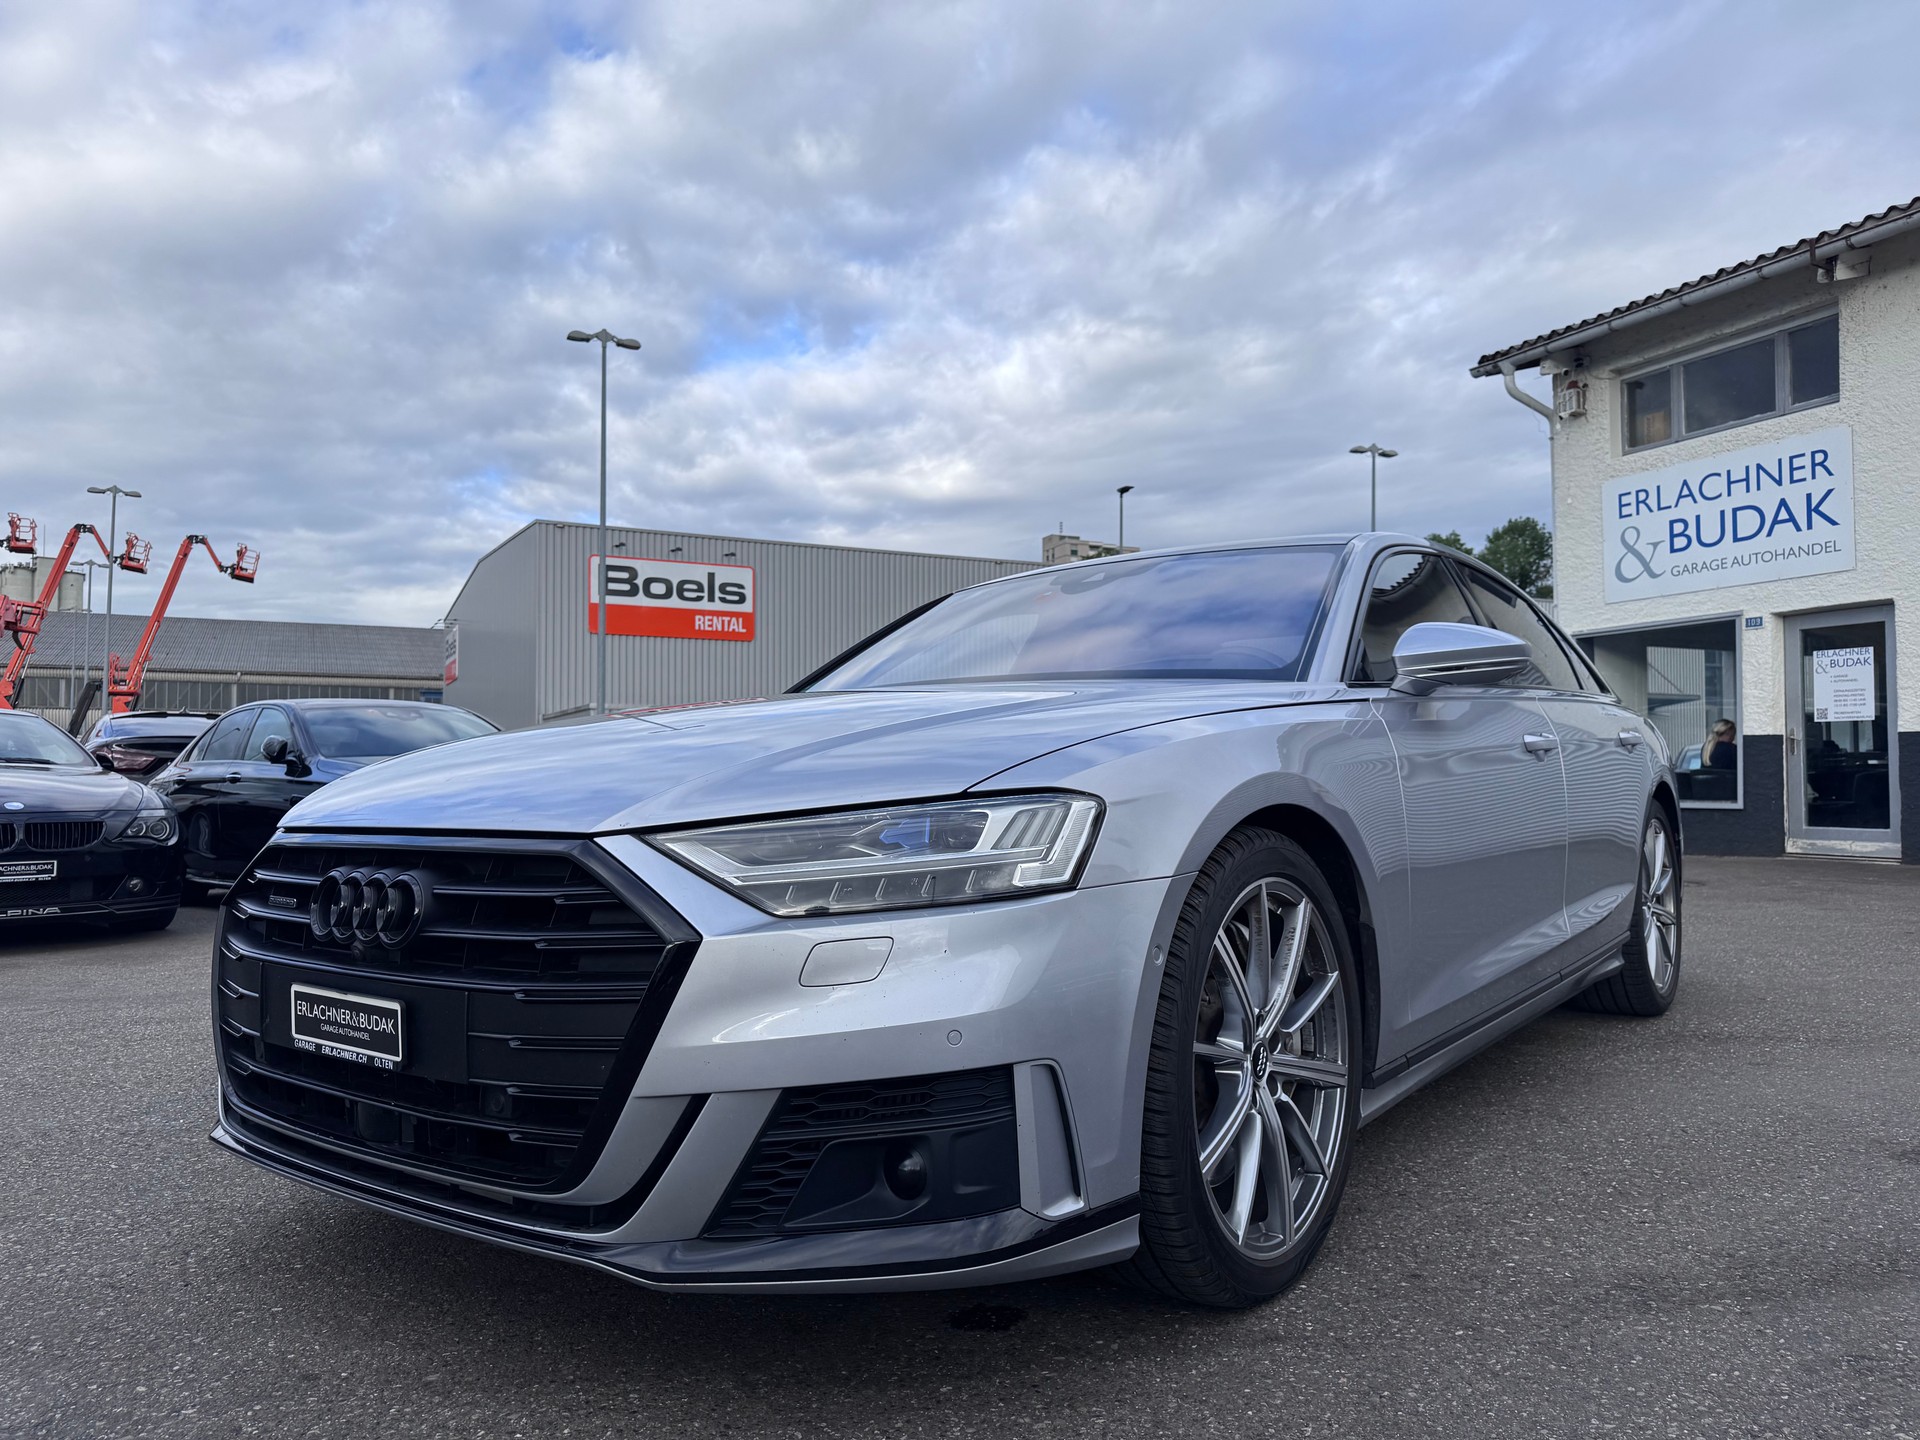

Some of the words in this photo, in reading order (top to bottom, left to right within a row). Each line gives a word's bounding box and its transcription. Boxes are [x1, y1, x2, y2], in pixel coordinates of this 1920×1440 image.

[1618, 449, 1834, 519] ERLACHNER
[1614, 526, 1666, 584] &
[1668, 488, 1840, 554] BUDAK
[1670, 557, 1728, 577] GARAGE
[1730, 540, 1842, 568] AUTOHANDEL
[598, 563, 746, 605] Boels
[695, 615, 746, 633] RENTAL
[1815, 660, 1829, 674] &
[1830, 657, 1871, 668] BUDAK
[1816, 648, 1870, 659] ERLACHNER
[320, 1023, 339, 1034] GARAGE
[339, 1028, 370, 1040] AUTOHANDEL
[294, 1039, 316, 1052] GARAGE
[321, 1045, 367, 1064] ERLACHNER.CH
[374, 1057, 393, 1070] OLTEN
